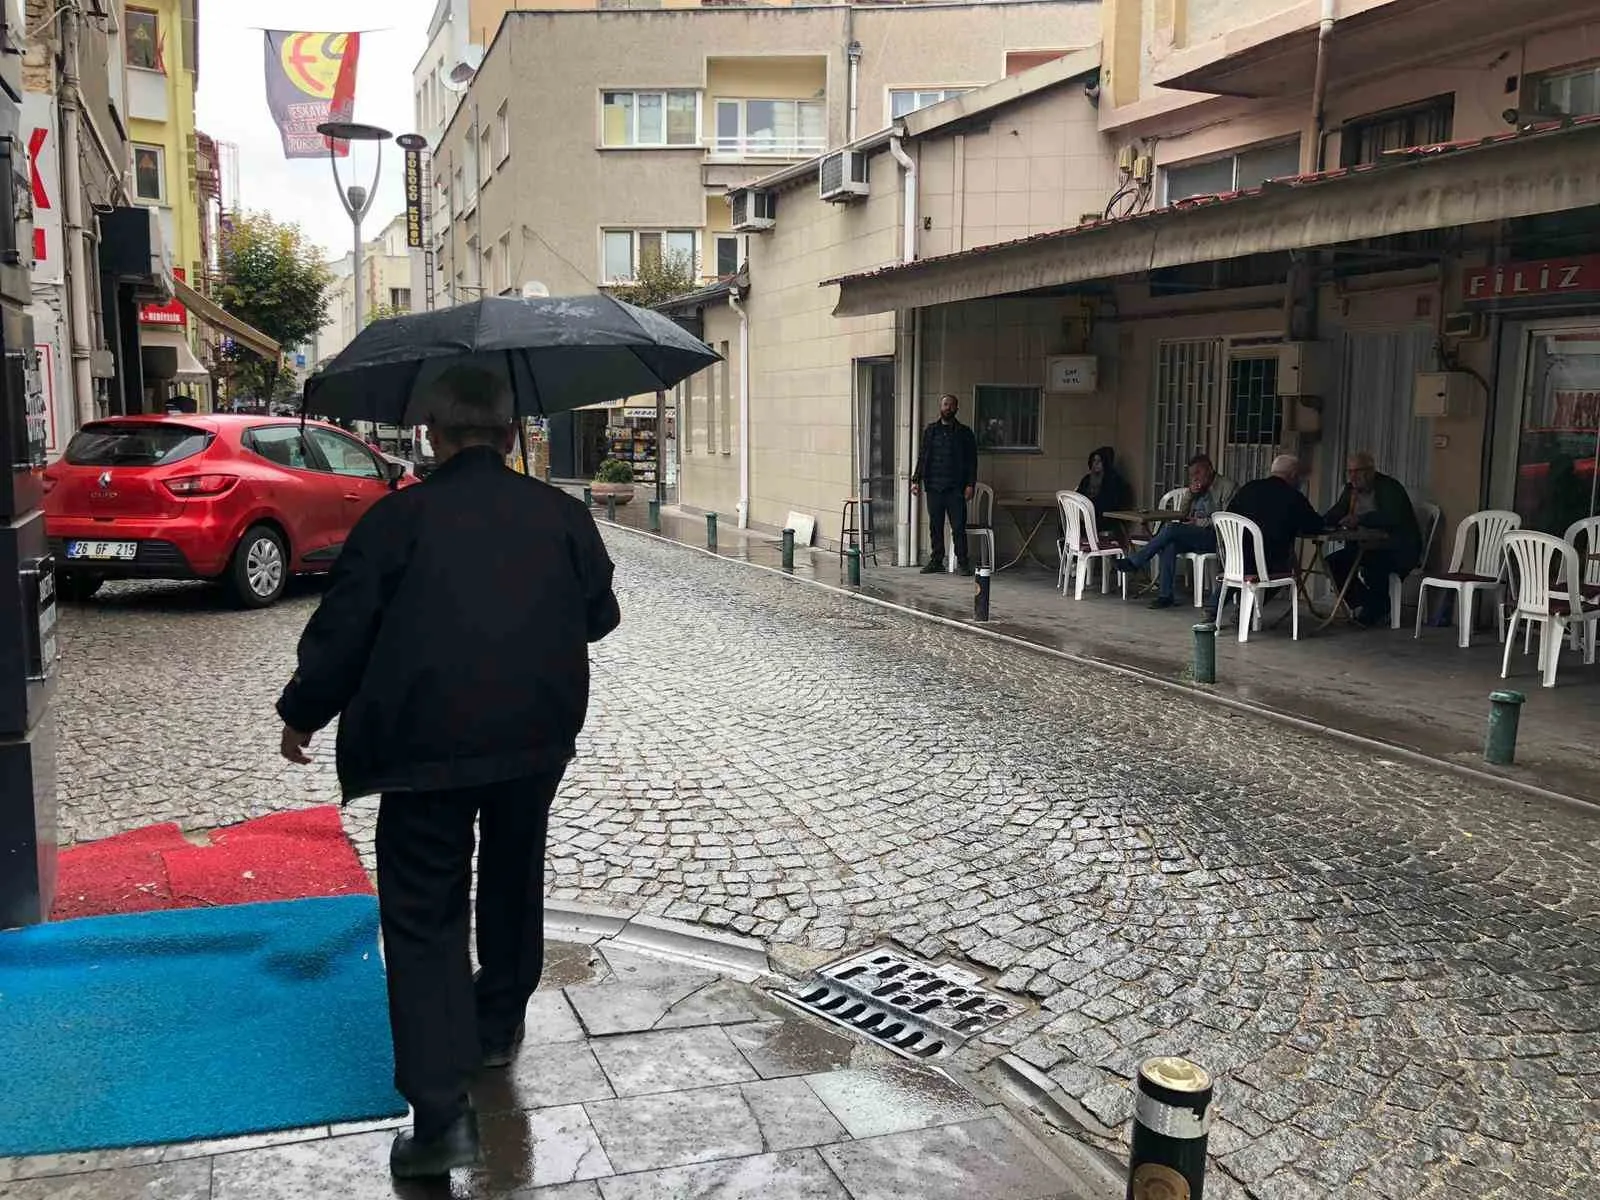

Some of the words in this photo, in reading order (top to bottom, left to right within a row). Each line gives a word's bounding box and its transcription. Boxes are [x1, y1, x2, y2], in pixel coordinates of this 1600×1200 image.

[1470, 263, 1582, 295] FİLİZ
[76, 543, 88, 555] 26
[96, 543, 109, 555] GF
[116, 543, 136, 556] 215
